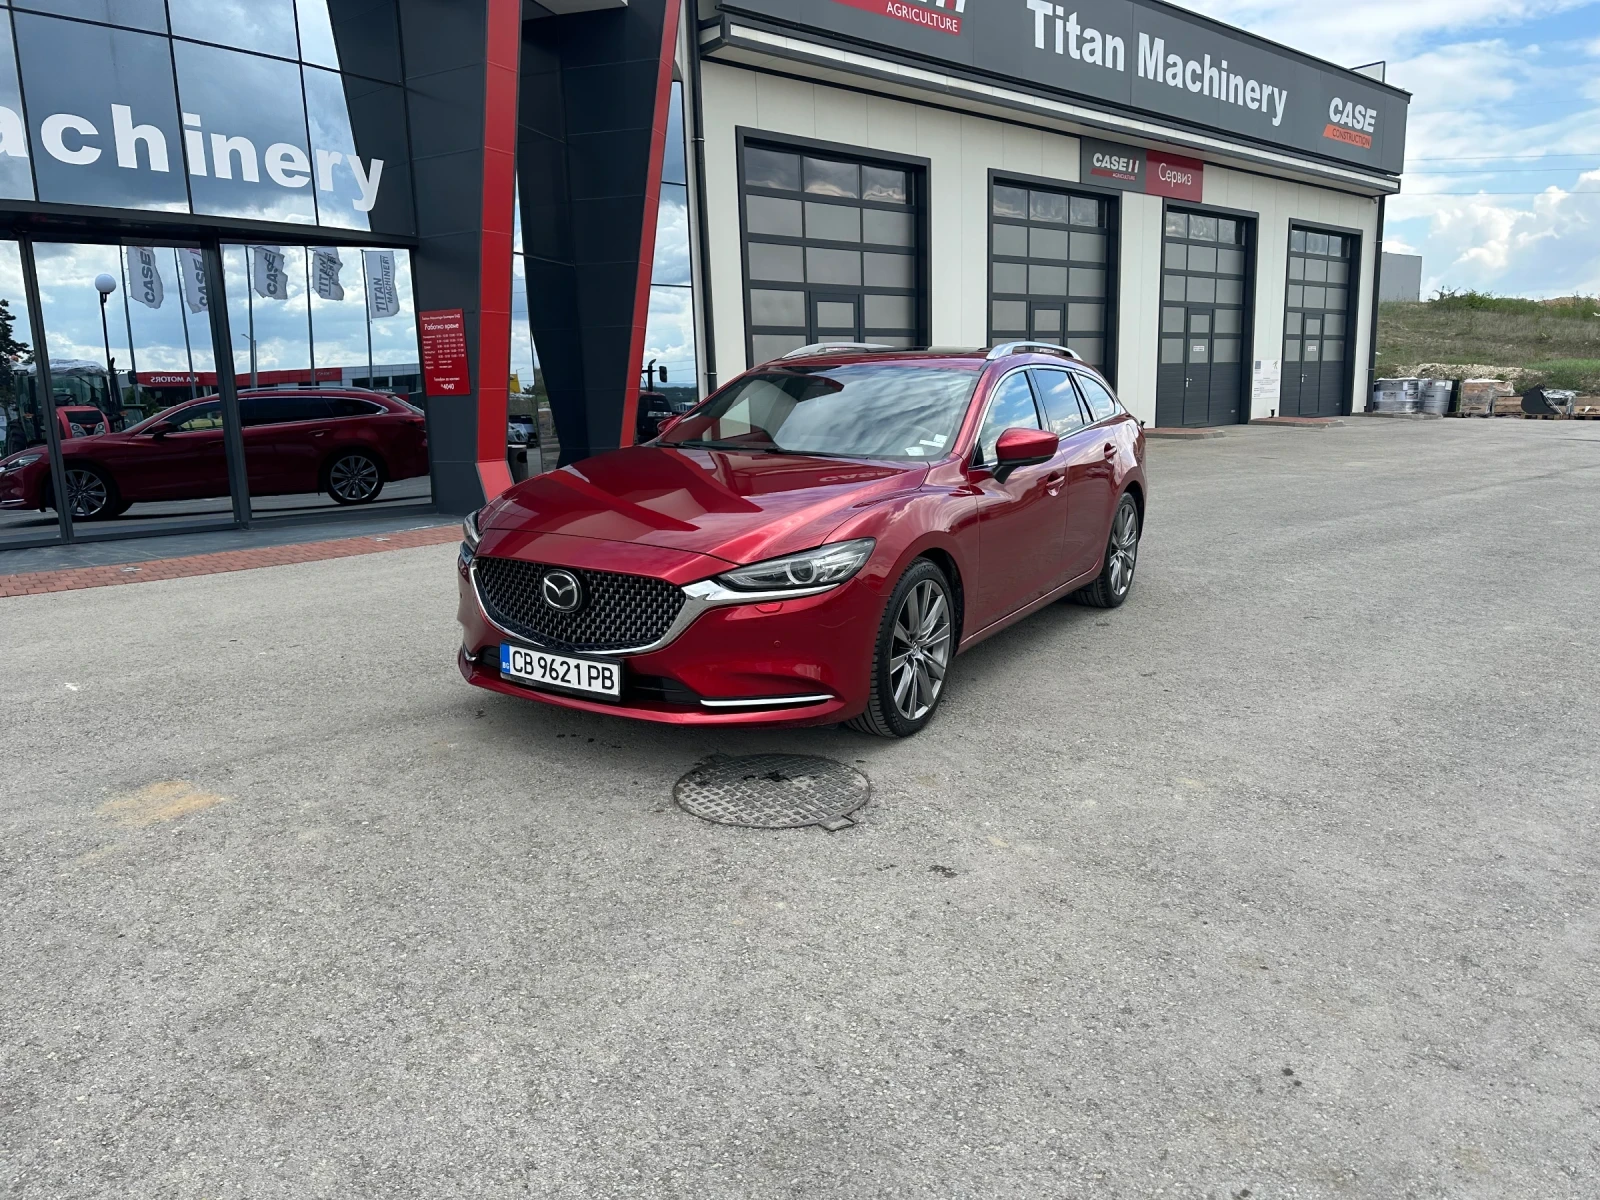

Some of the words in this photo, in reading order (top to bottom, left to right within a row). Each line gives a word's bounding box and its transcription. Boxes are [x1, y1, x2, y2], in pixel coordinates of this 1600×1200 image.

[886, 1, 958, 32] AGRICULTURE
[1026, 0, 1125, 72] Titan
[1137, 31, 1288, 127] Machinery
[1329, 97, 1377, 133] CASE
[1332, 128, 1370, 147] CONSTRUCTION
[1093, 152, 1128, 172] CASE
[1158, 162, 1192, 187] Сервиз
[140, 249, 156, 304] CASE
[264, 253, 279, 295] CASE
[382, 255, 393, 304] MACHINERY
[373, 277, 387, 312] TITAN
[502, 661, 510, 670] BG
[512, 650, 534, 675] CB
[537, 656, 581, 685] 9621
[587, 664, 615, 690] PB
